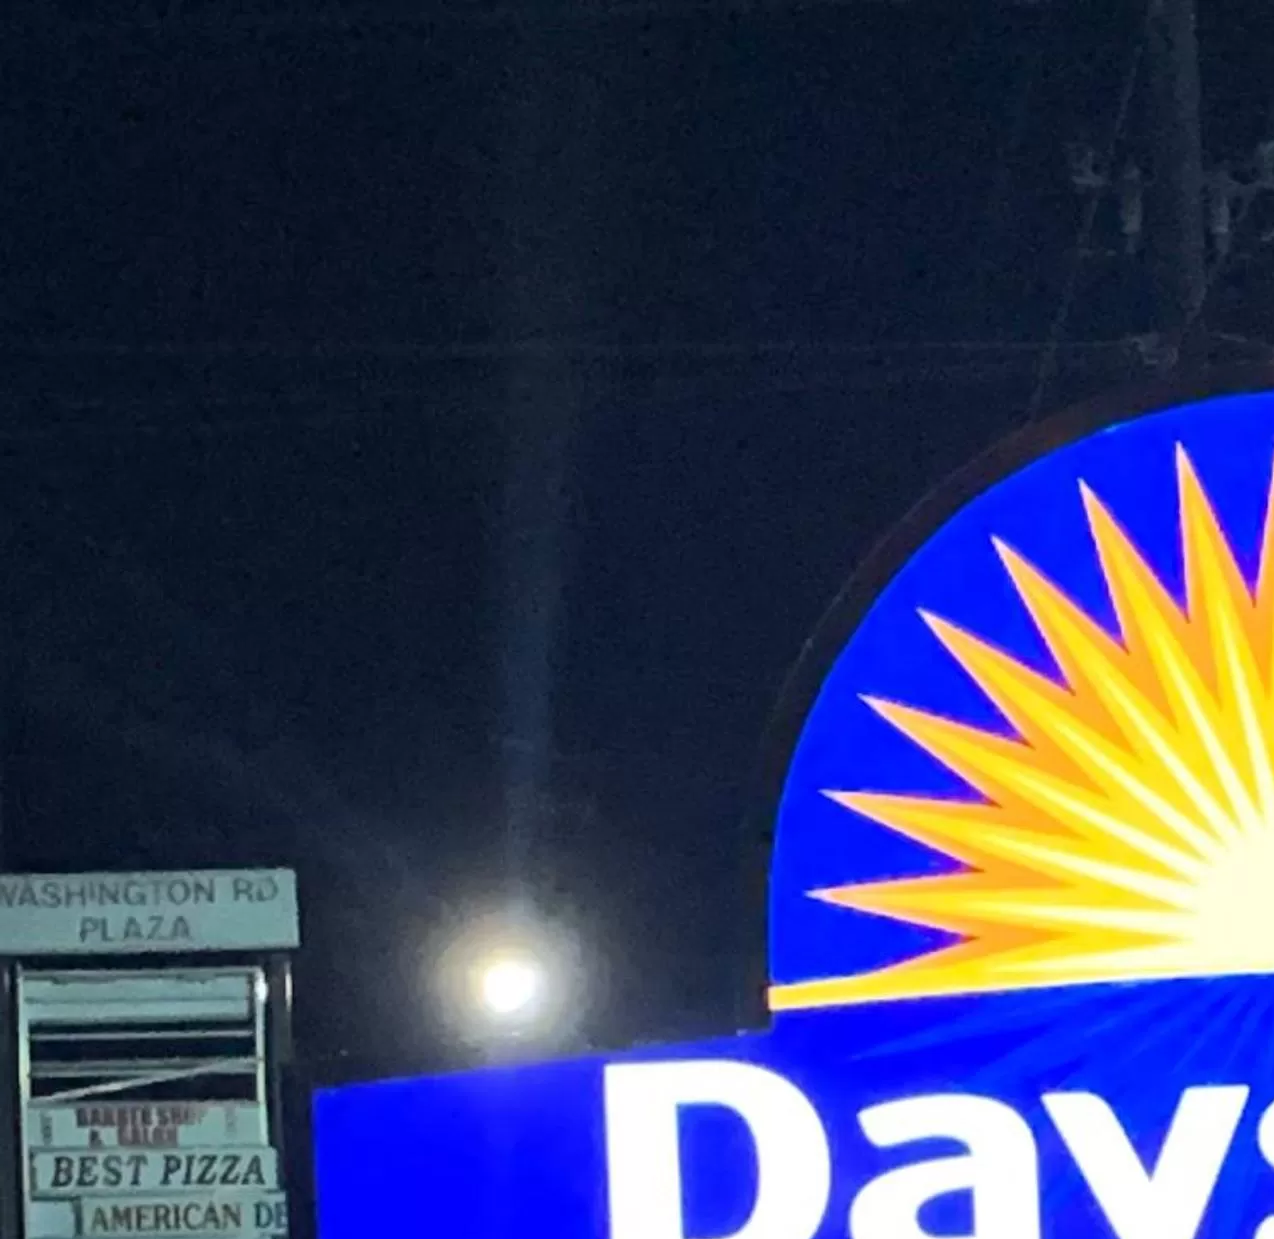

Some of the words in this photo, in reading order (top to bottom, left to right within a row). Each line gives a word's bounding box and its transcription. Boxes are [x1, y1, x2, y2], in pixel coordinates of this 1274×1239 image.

[232, 876, 279, 904] RD
[79, 914, 192, 943] PLAZA
[51, 1155, 148, 1188] BEST
[159, 1154, 266, 1186] PIZZA
[91, 1202, 242, 1233] AMERICAN
